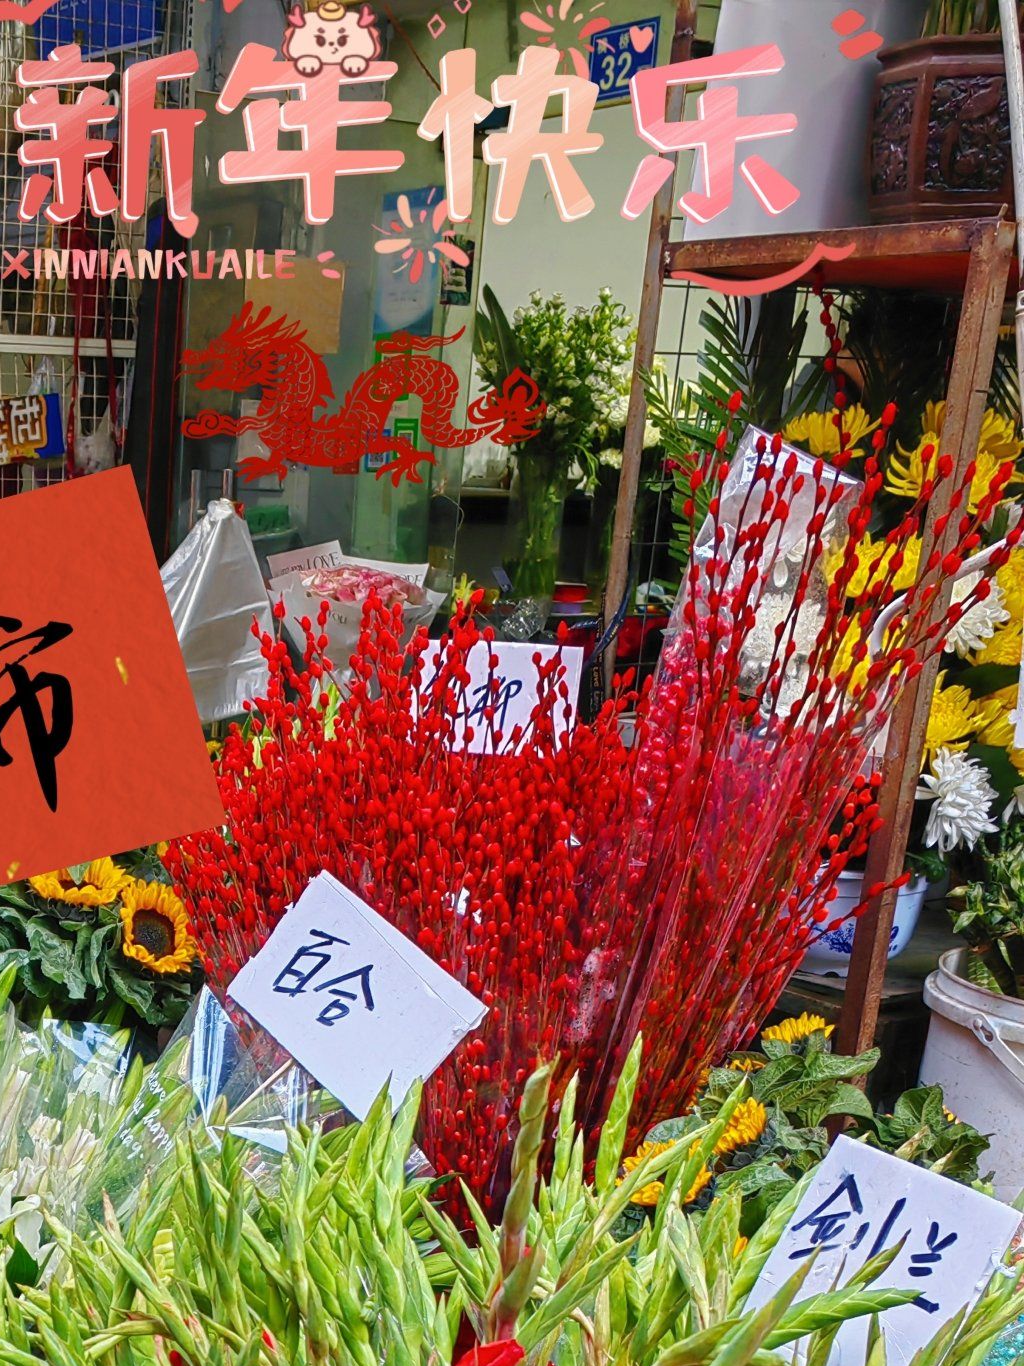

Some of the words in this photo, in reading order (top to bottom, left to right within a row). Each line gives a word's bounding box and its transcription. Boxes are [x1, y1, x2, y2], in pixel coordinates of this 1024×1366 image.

[599, 51, 632, 91] 32
[272, 928, 375, 1026] 百合
[788, 1173, 960, 1314] 剑兰
